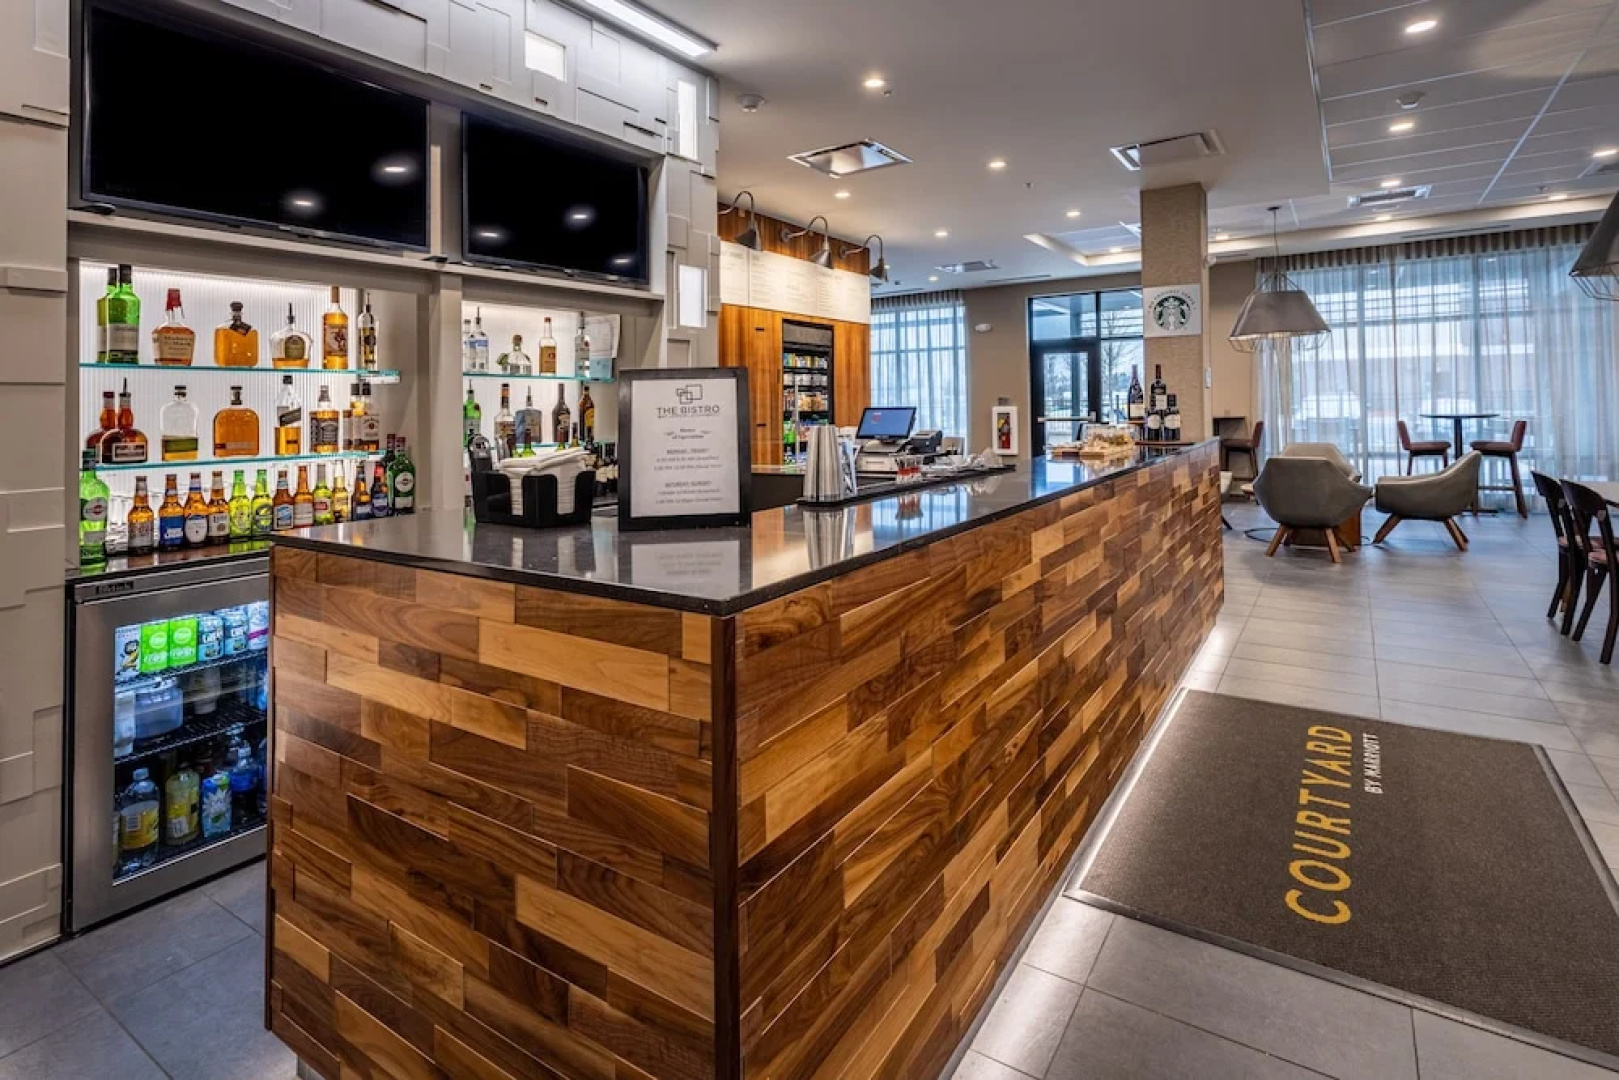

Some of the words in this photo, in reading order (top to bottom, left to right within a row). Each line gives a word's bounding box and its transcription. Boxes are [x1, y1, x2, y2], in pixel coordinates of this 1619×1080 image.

[657, 406, 677, 415] THE
[681, 405, 720, 414] BISTRO
[1364, 778, 1383, 794] BY
[1284, 724, 1353, 925] COURTYARD
